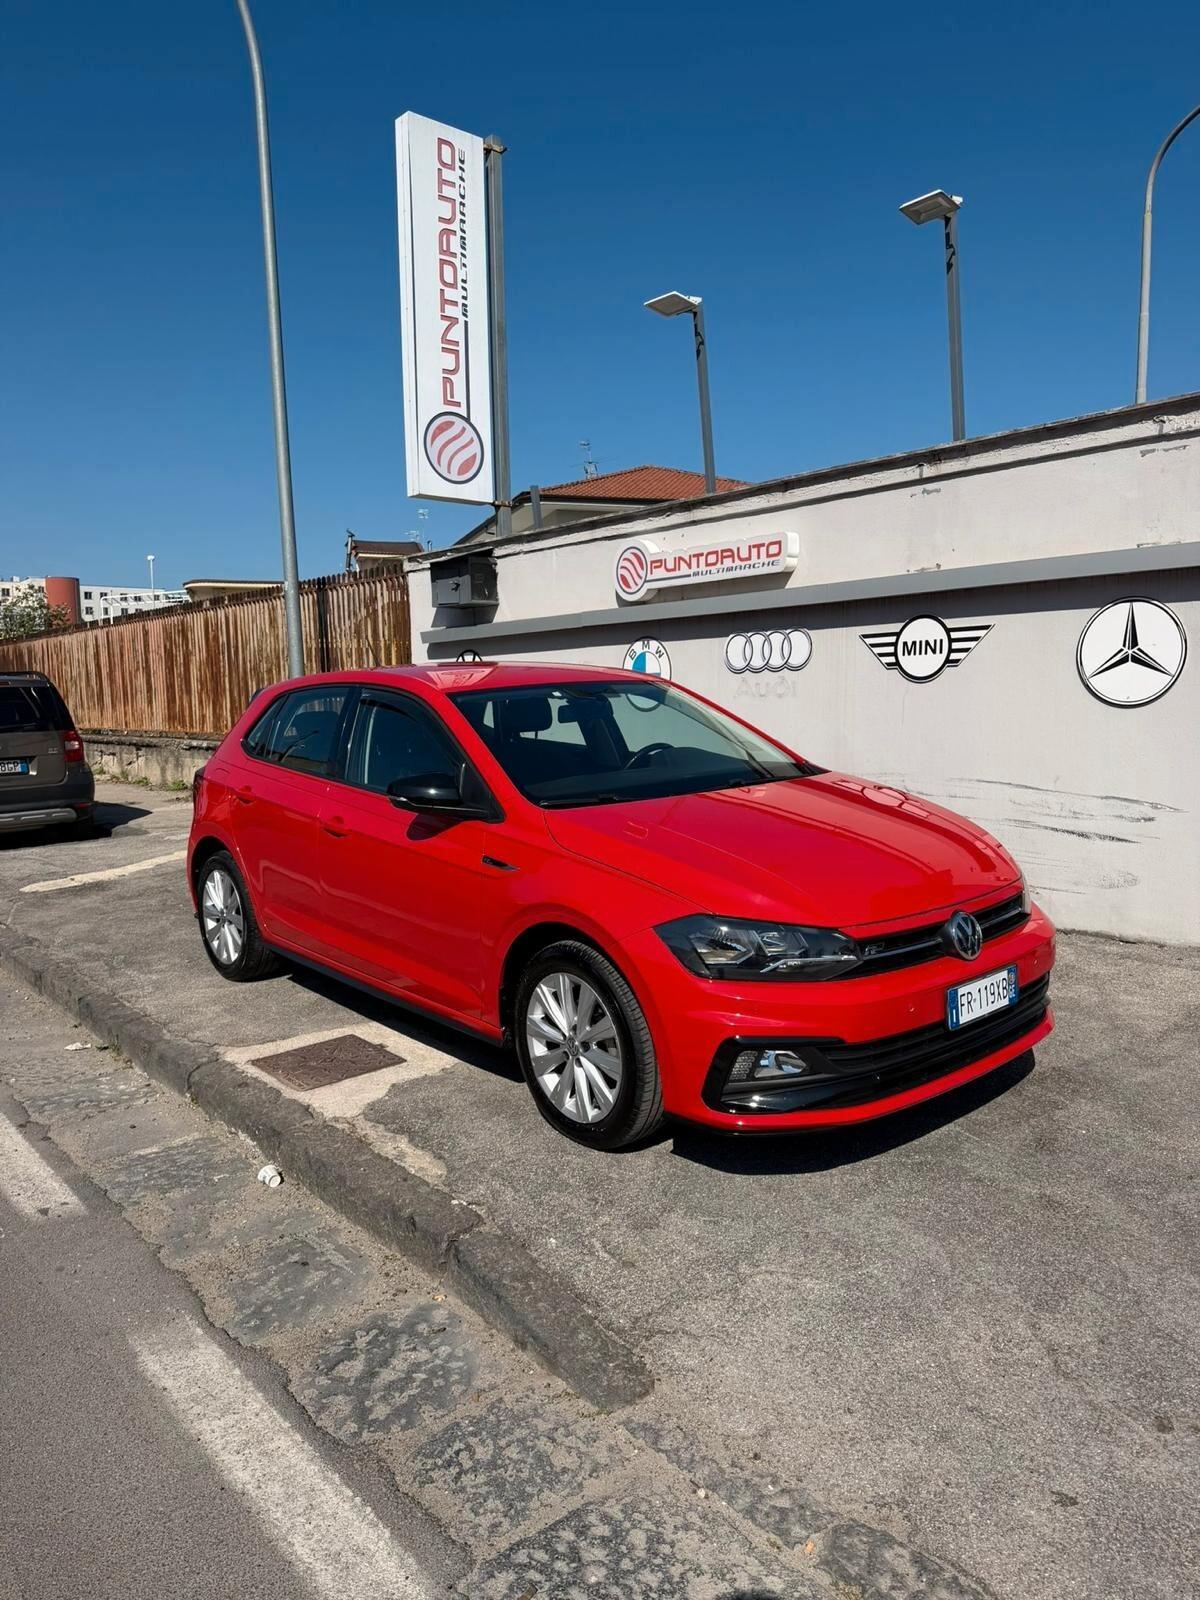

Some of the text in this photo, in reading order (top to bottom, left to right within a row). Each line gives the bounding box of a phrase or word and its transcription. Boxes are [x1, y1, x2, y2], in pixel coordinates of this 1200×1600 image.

[457, 148, 469, 319] MULTIMARCHE
[437, 137, 461, 408] PUNTOAUTO
[650, 540, 782, 575] PUNTOAUTO
[691, 560, 781, 578] MULTIMARCHE
[629, 639, 664, 660] BMW
[901, 638, 944, 657] MINI
